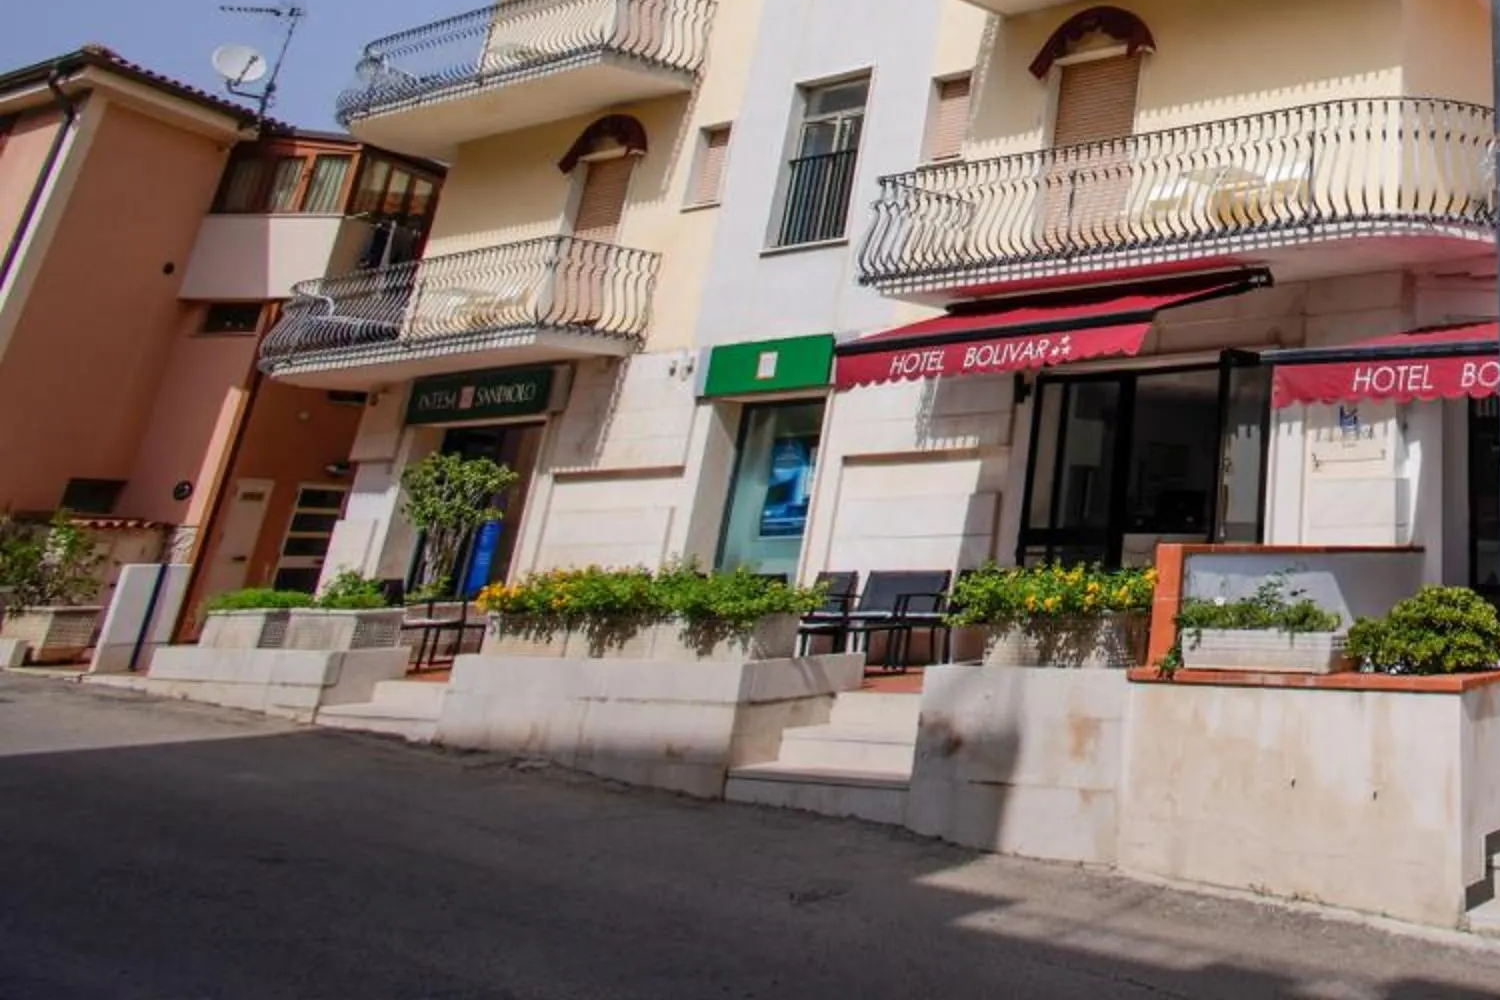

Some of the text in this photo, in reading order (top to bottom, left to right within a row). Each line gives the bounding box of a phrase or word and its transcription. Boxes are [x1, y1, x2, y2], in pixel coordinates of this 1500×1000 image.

[889, 338, 1050, 375] HOTEL BOLIVAR
[1352, 364, 1434, 392] HOTEL
